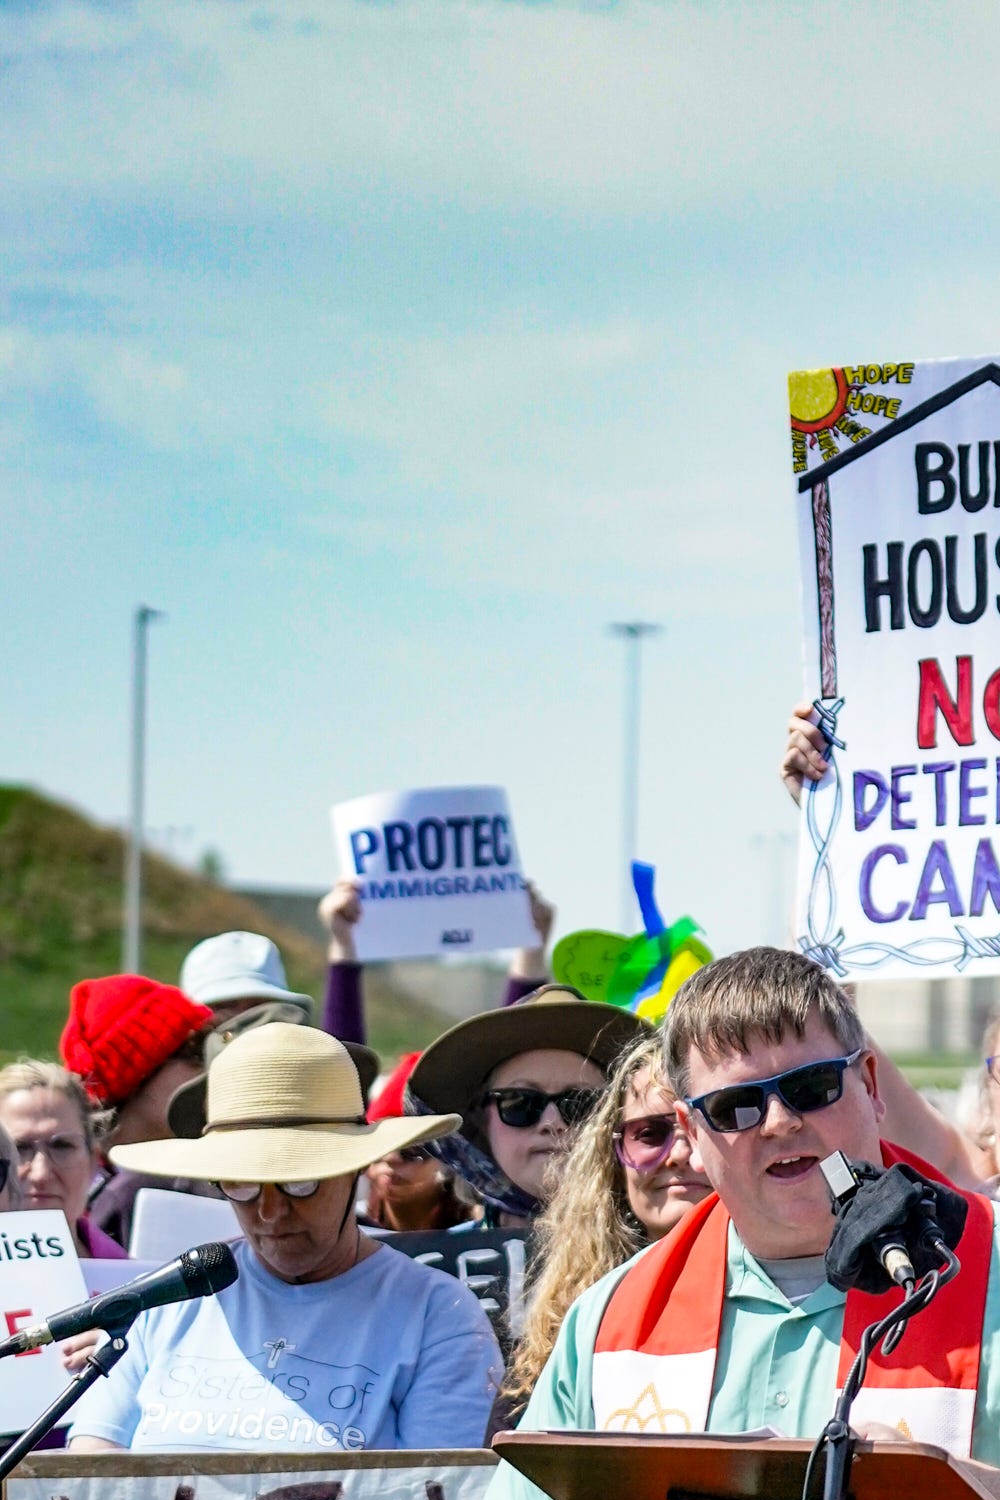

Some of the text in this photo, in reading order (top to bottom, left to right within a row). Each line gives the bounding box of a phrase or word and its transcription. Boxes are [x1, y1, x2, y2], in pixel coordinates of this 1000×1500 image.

[842, 362, 915, 385] HOPE
[846, 391, 902, 419] HOPE
[0, 1231, 65, 1262] ists
[158, 1363, 376, 1414] Sisters of
[141, 1401, 367, 1451] Providence
